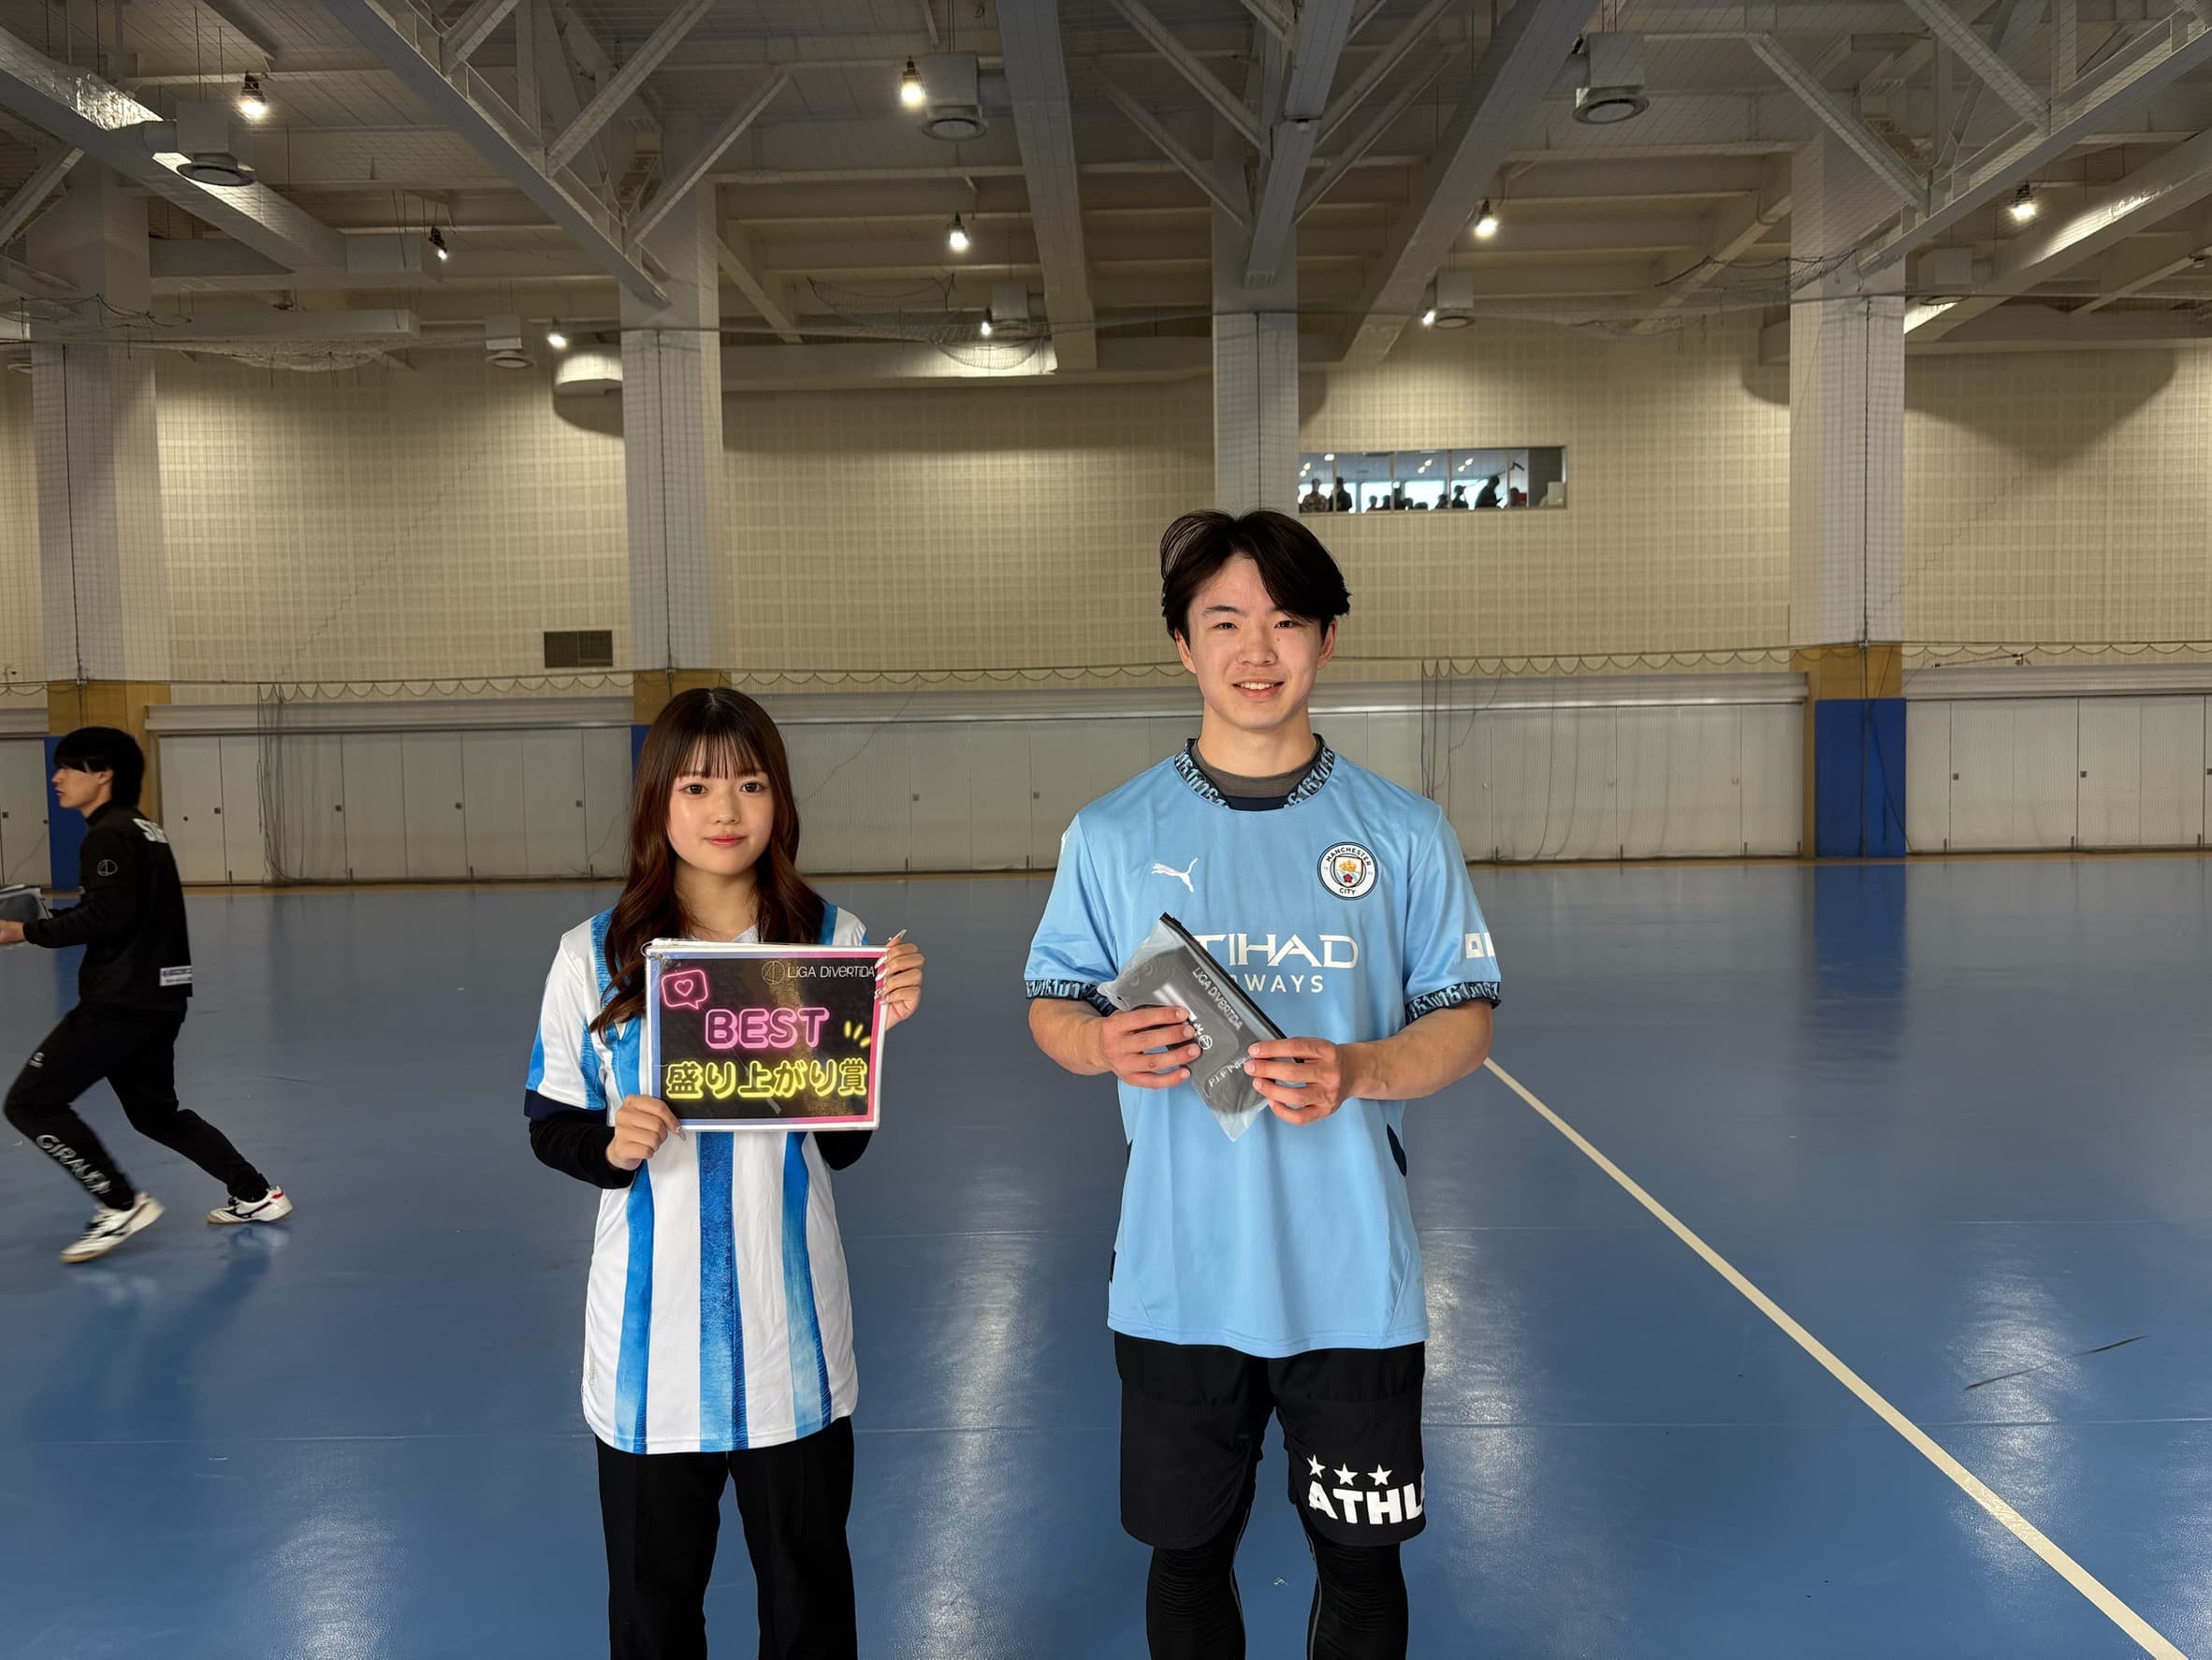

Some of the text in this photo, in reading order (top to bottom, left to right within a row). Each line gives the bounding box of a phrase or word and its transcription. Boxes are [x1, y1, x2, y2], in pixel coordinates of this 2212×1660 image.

[1326, 847, 1372, 866] MANCHESTER
[1339, 887, 1356, 896] CITY
[1192, 934, 1359, 968] TIHAD
[1232, 973, 1324, 994] WAYS
[705, 1007, 830, 1050] BEST
[665, 1056, 869, 1099] 盛り上がり賞
